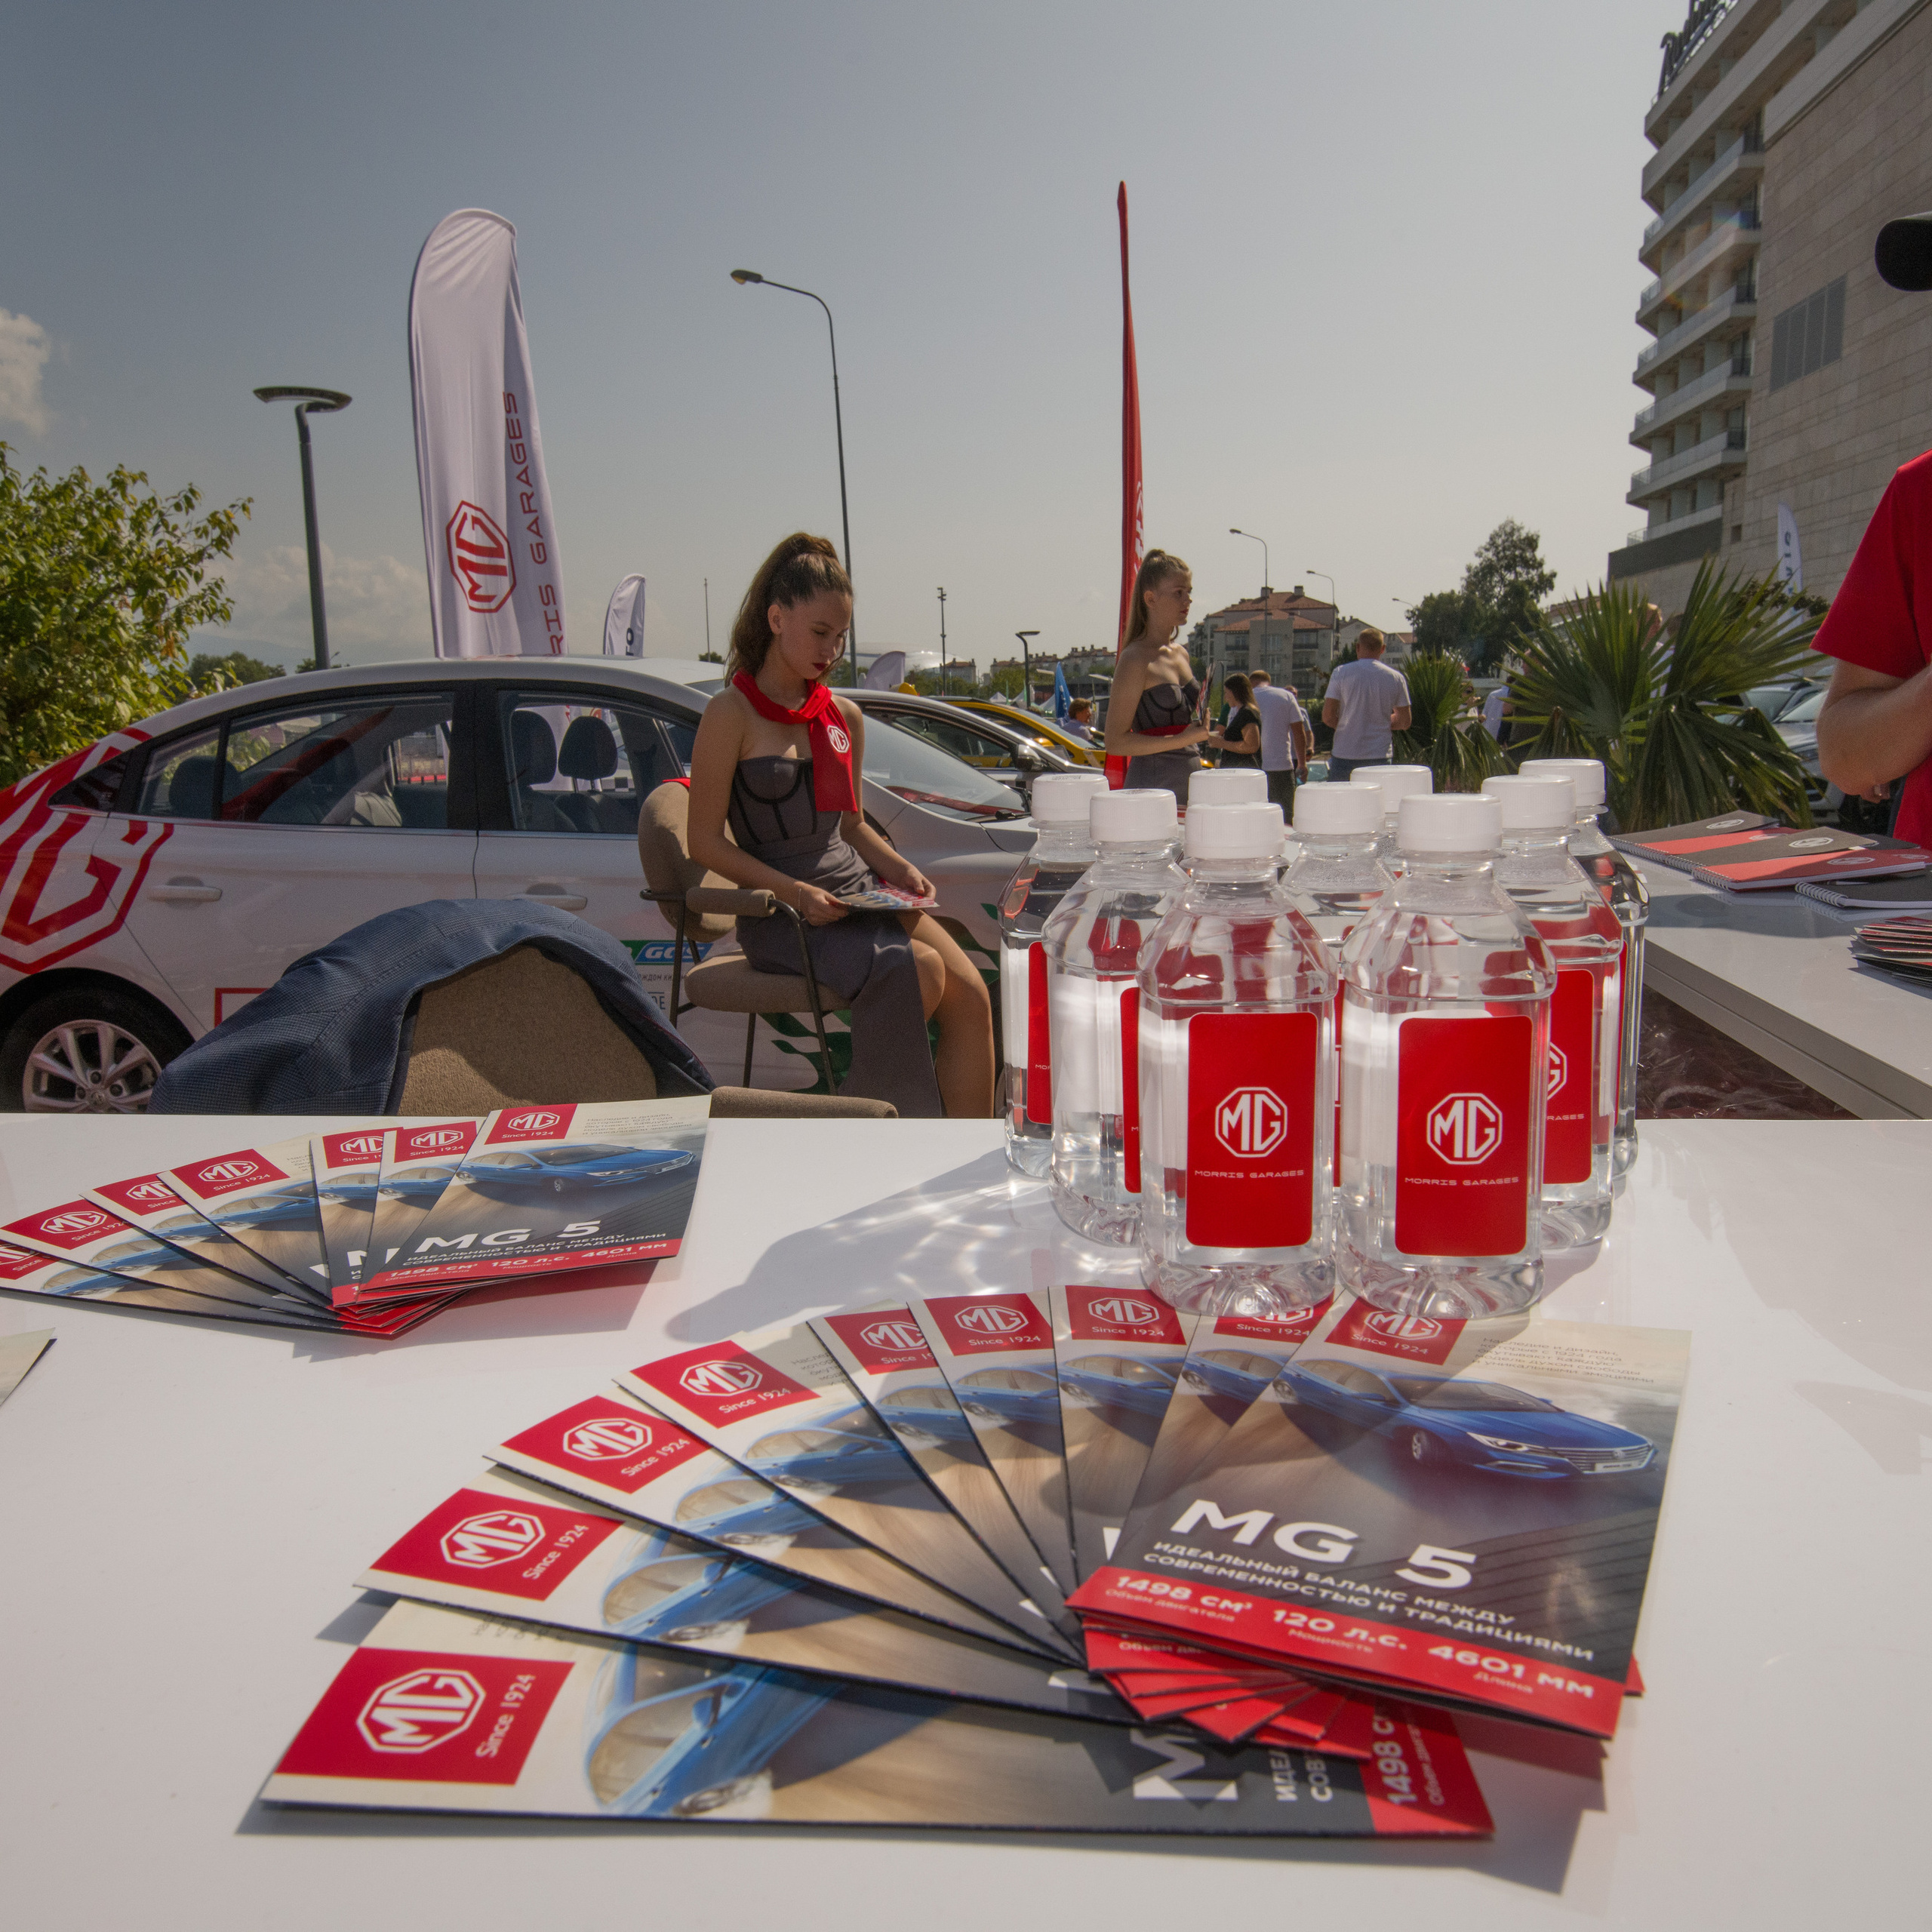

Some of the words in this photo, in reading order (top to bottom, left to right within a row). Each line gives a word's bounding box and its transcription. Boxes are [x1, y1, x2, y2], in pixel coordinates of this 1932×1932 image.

[503, 391, 547, 565] GARAGES
[454, 510, 509, 606] MG
[829, 727, 847, 751] MG
[511, 1113, 556, 1130] MG
[1220, 1092, 1282, 1153] MG
[1432, 1098, 1497, 1161] MG
[414, 1131, 460, 1147] MG
[204, 1161, 255, 1180] MG
[1194, 1169, 1244, 1180] MORRIS
[1250, 1168, 1305, 1180] GARAGES
[1404, 1177, 1457, 1187] MORRIS
[1462, 1175, 1520, 1187] GARAGES
[213, 1181, 242, 1192] Since
[245, 1174, 271, 1183] 1924
[146, 1198, 177, 1209] Since
[45, 1211, 103, 1233] MG
[70, 1229, 102, 1241] Since
[414, 1228, 532, 1254] MG
[556, 1220, 601, 1238] 5
[402, 1247, 546, 1266] СОВРЕМЕННОСТЬЮ
[565, 1233, 667, 1249] ТРАДИЦИЯМИ
[407, 1246, 501, 1262] ИДЕАЛЬНЫЙ
[505, 1240, 566, 1252] БАЛАНС
[571, 1233, 626, 1244] МЕЖДУ
[581, 1246, 632, 1259] 4601
[12, 1258, 43, 1272] Since
[390, 1266, 439, 1278] 1498
[491, 1259, 528, 1267] 120
[960, 1306, 1024, 1333] MG
[1091, 1298, 1155, 1324] MG
[1091, 1326, 1126, 1334] Since
[1133, 1327, 1165, 1337] 1924
[1236, 1323, 1271, 1334] Since
[1278, 1327, 1310, 1337] 1924
[1367, 1312, 1436, 1338] MG
[968, 1337, 1004, 1346] Since
[1008, 1335, 1041, 1344] 1924
[1350, 1333, 1388, 1346] Since
[1394, 1342, 1429, 1355] 1924
[1481, 1343, 1538, 1353] которые
[1484, 1337, 1549, 1349] Наследие
[881, 1355, 916, 1364] Since
[1475, 1354, 1526, 1364] модель
[1528, 1359, 1574, 1368] духом
[1577, 1364, 1641, 1376] свободы
[1477, 1349, 1552, 1360] окутывают
[1556, 1357, 1615, 1367] каждую
[682, 1361, 760, 1395] MG
[1484, 1361, 1578, 1375] уникальными
[1582, 1371, 1654, 1383] эмоциями
[718, 1397, 758, 1415] Since
[756, 1386, 792, 1403] 1924
[565, 1419, 650, 1459] MG
[620, 1454, 658, 1477] Since
[655, 1437, 690, 1460] 1924
[451, 1512, 539, 1565] MG
[1170, 1498, 1358, 1563] MG
[1394, 1543, 1476, 1589] 5
[521, 1549, 561, 1580] Since
[553, 1522, 590, 1549] 1924
[1116, 1575, 1192, 1601] 1498
[1152, 1540, 1300, 1580] ИДЕАЛЬНЫЙ
[1303, 1571, 1409, 1603] БАЛАНС
[1414, 1595, 1516, 1625] МЕЖДУ
[1143, 1552, 1371, 1608] СОВРЕМЕННОСТЬЮ
[1377, 1601, 1397, 1614] И
[1404, 1605, 1595, 1661] ТРАДИЦИЯМИ
[1273, 1609, 1336, 1632] 120
[1428, 1644, 1525, 1679] 4601
[368, 1673, 476, 1745] MG
[475, 1714, 515, 1758] Since
[500, 1673, 536, 1709] 1924
[1372, 1740, 1418, 1805] 1498
